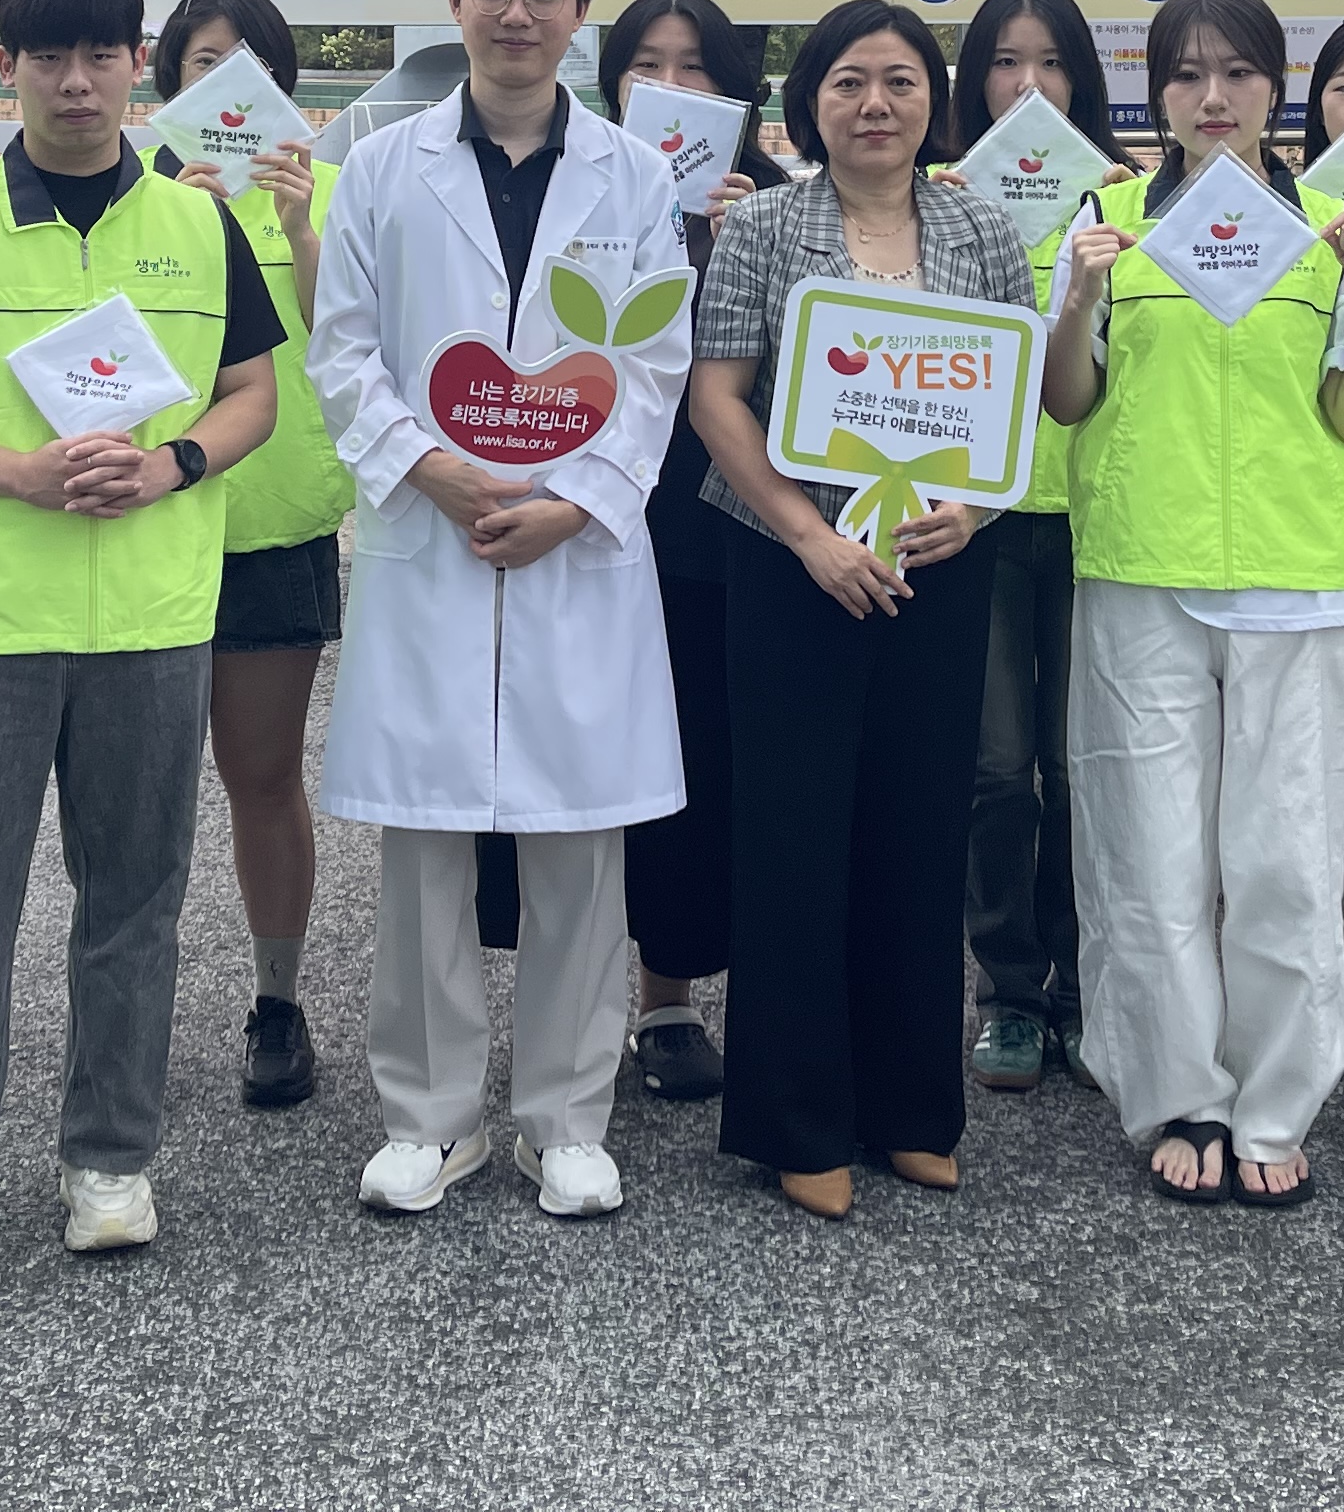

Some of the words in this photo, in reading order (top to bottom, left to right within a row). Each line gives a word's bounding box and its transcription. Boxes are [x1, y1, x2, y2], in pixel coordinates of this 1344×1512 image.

[1000, 175, 1061, 190] 희망의씨앗
[1192, 243, 1260, 258] 희망의씨앗
[881, 353, 992, 390] YES!
[469, 380, 505, 402] 나는
[510, 384, 580, 407] 장기기증
[837, 389, 877, 406] 소중한
[881, 396, 920, 413] 선택을
[924, 401, 939, 417] 한
[941, 404, 974, 424] 당신.
[450, 404, 589, 434] 희망등록자입니다
[831, 407, 885, 429] 누구보다
[890, 417, 975, 443] 아름답습니다.
[473, 434, 558, 451] www.lisa.or.kr
